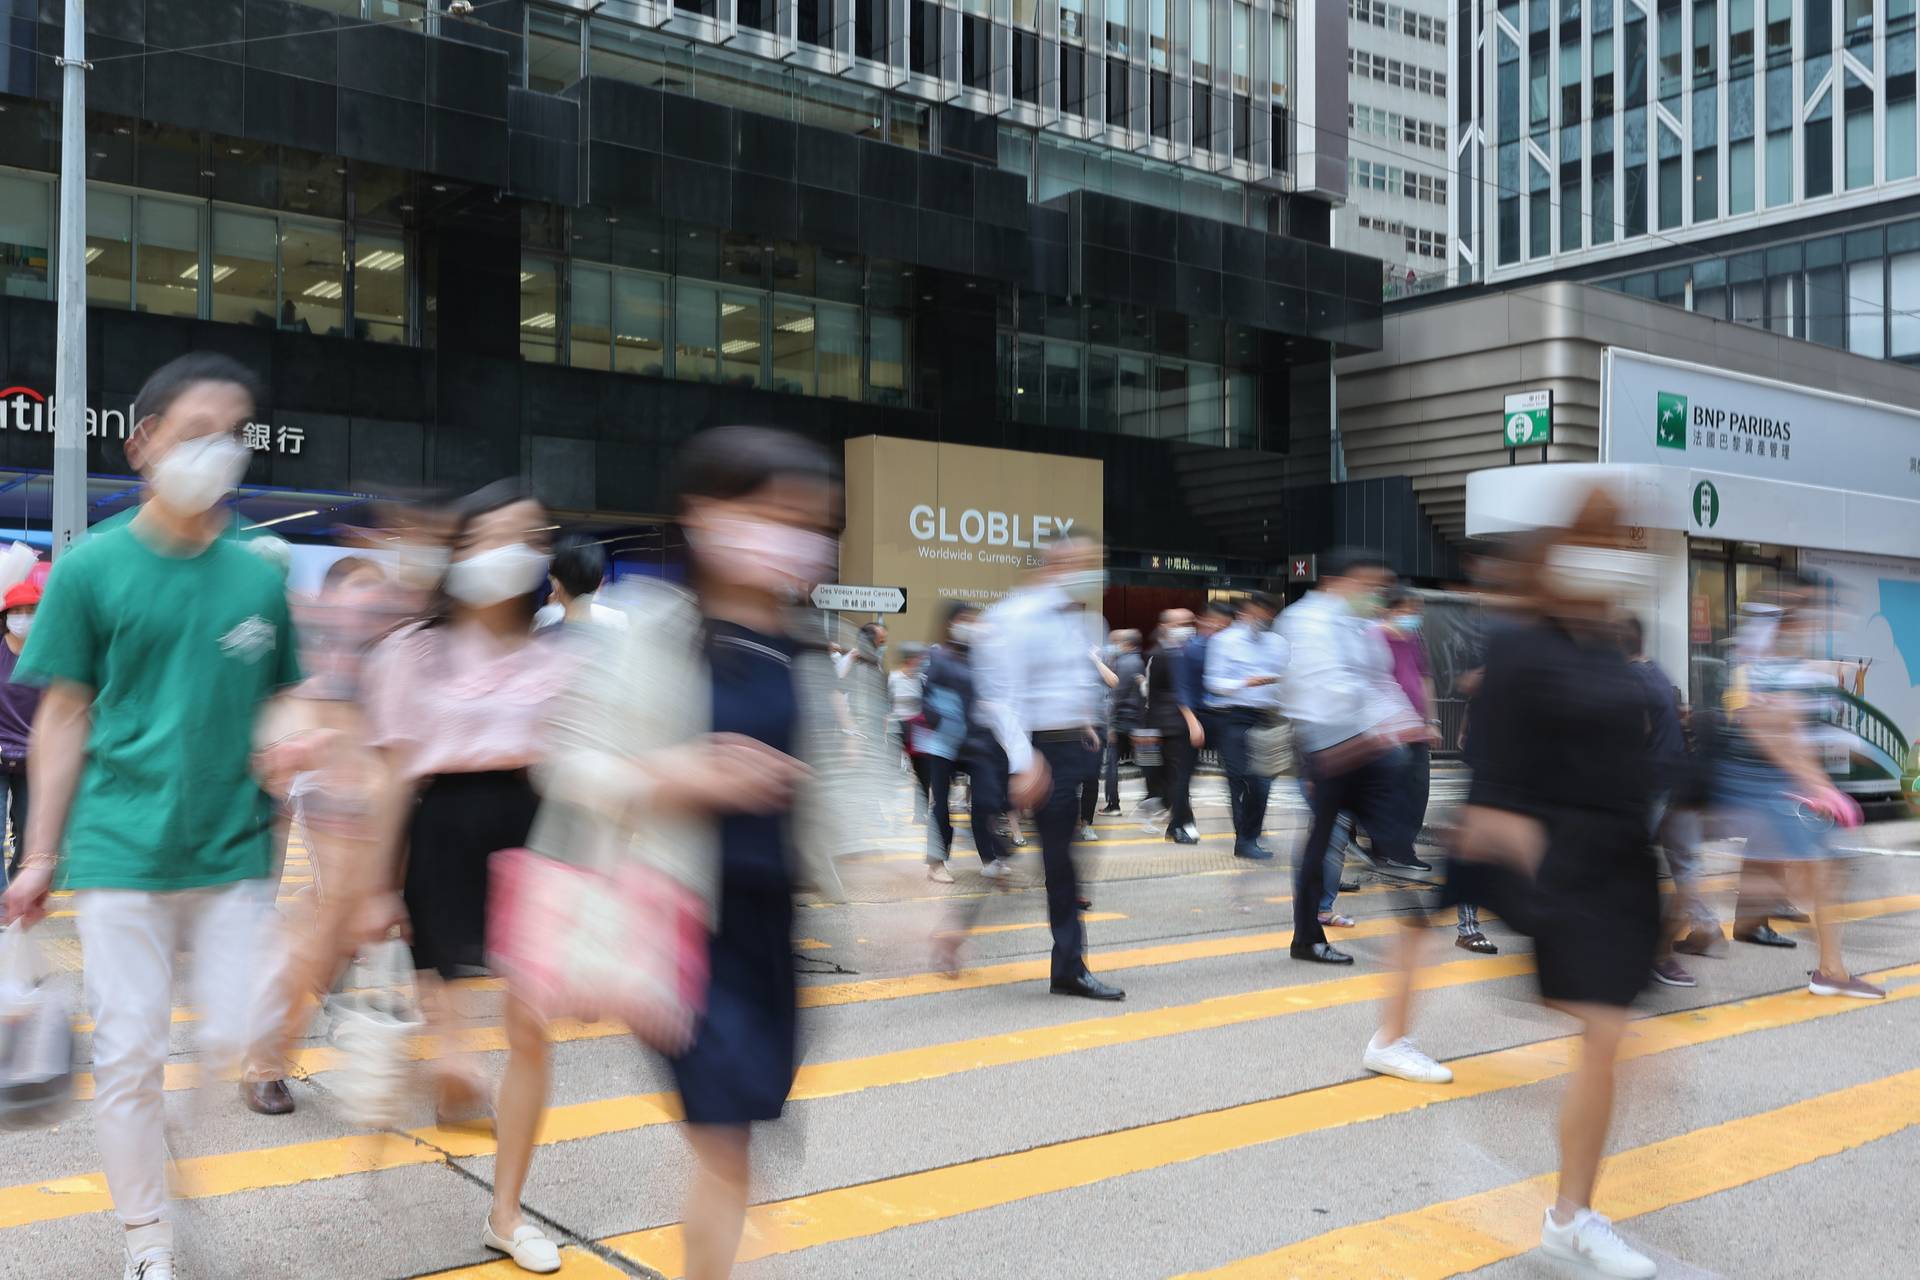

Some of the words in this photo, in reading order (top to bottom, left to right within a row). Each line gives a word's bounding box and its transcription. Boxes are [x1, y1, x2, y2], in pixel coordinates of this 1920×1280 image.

[242, 421, 305, 454] 銀行
[1693, 405, 1726, 429] BNP
[1729, 411, 1791, 441] PARIBAS
[1692, 429, 1791, 460] 法國巴黎資產管理
[909, 504, 1075, 550] GLOBLEX
[918, 545, 973, 561] Worldwide
[978, 550, 1022, 568] Currency
[834, 588, 853, 596] Voeux
[855, 589, 872, 597] Road
[873, 590, 896, 598] Central
[938, 587, 958, 596] YOUR
[959, 589, 989, 598] TRUSTED
